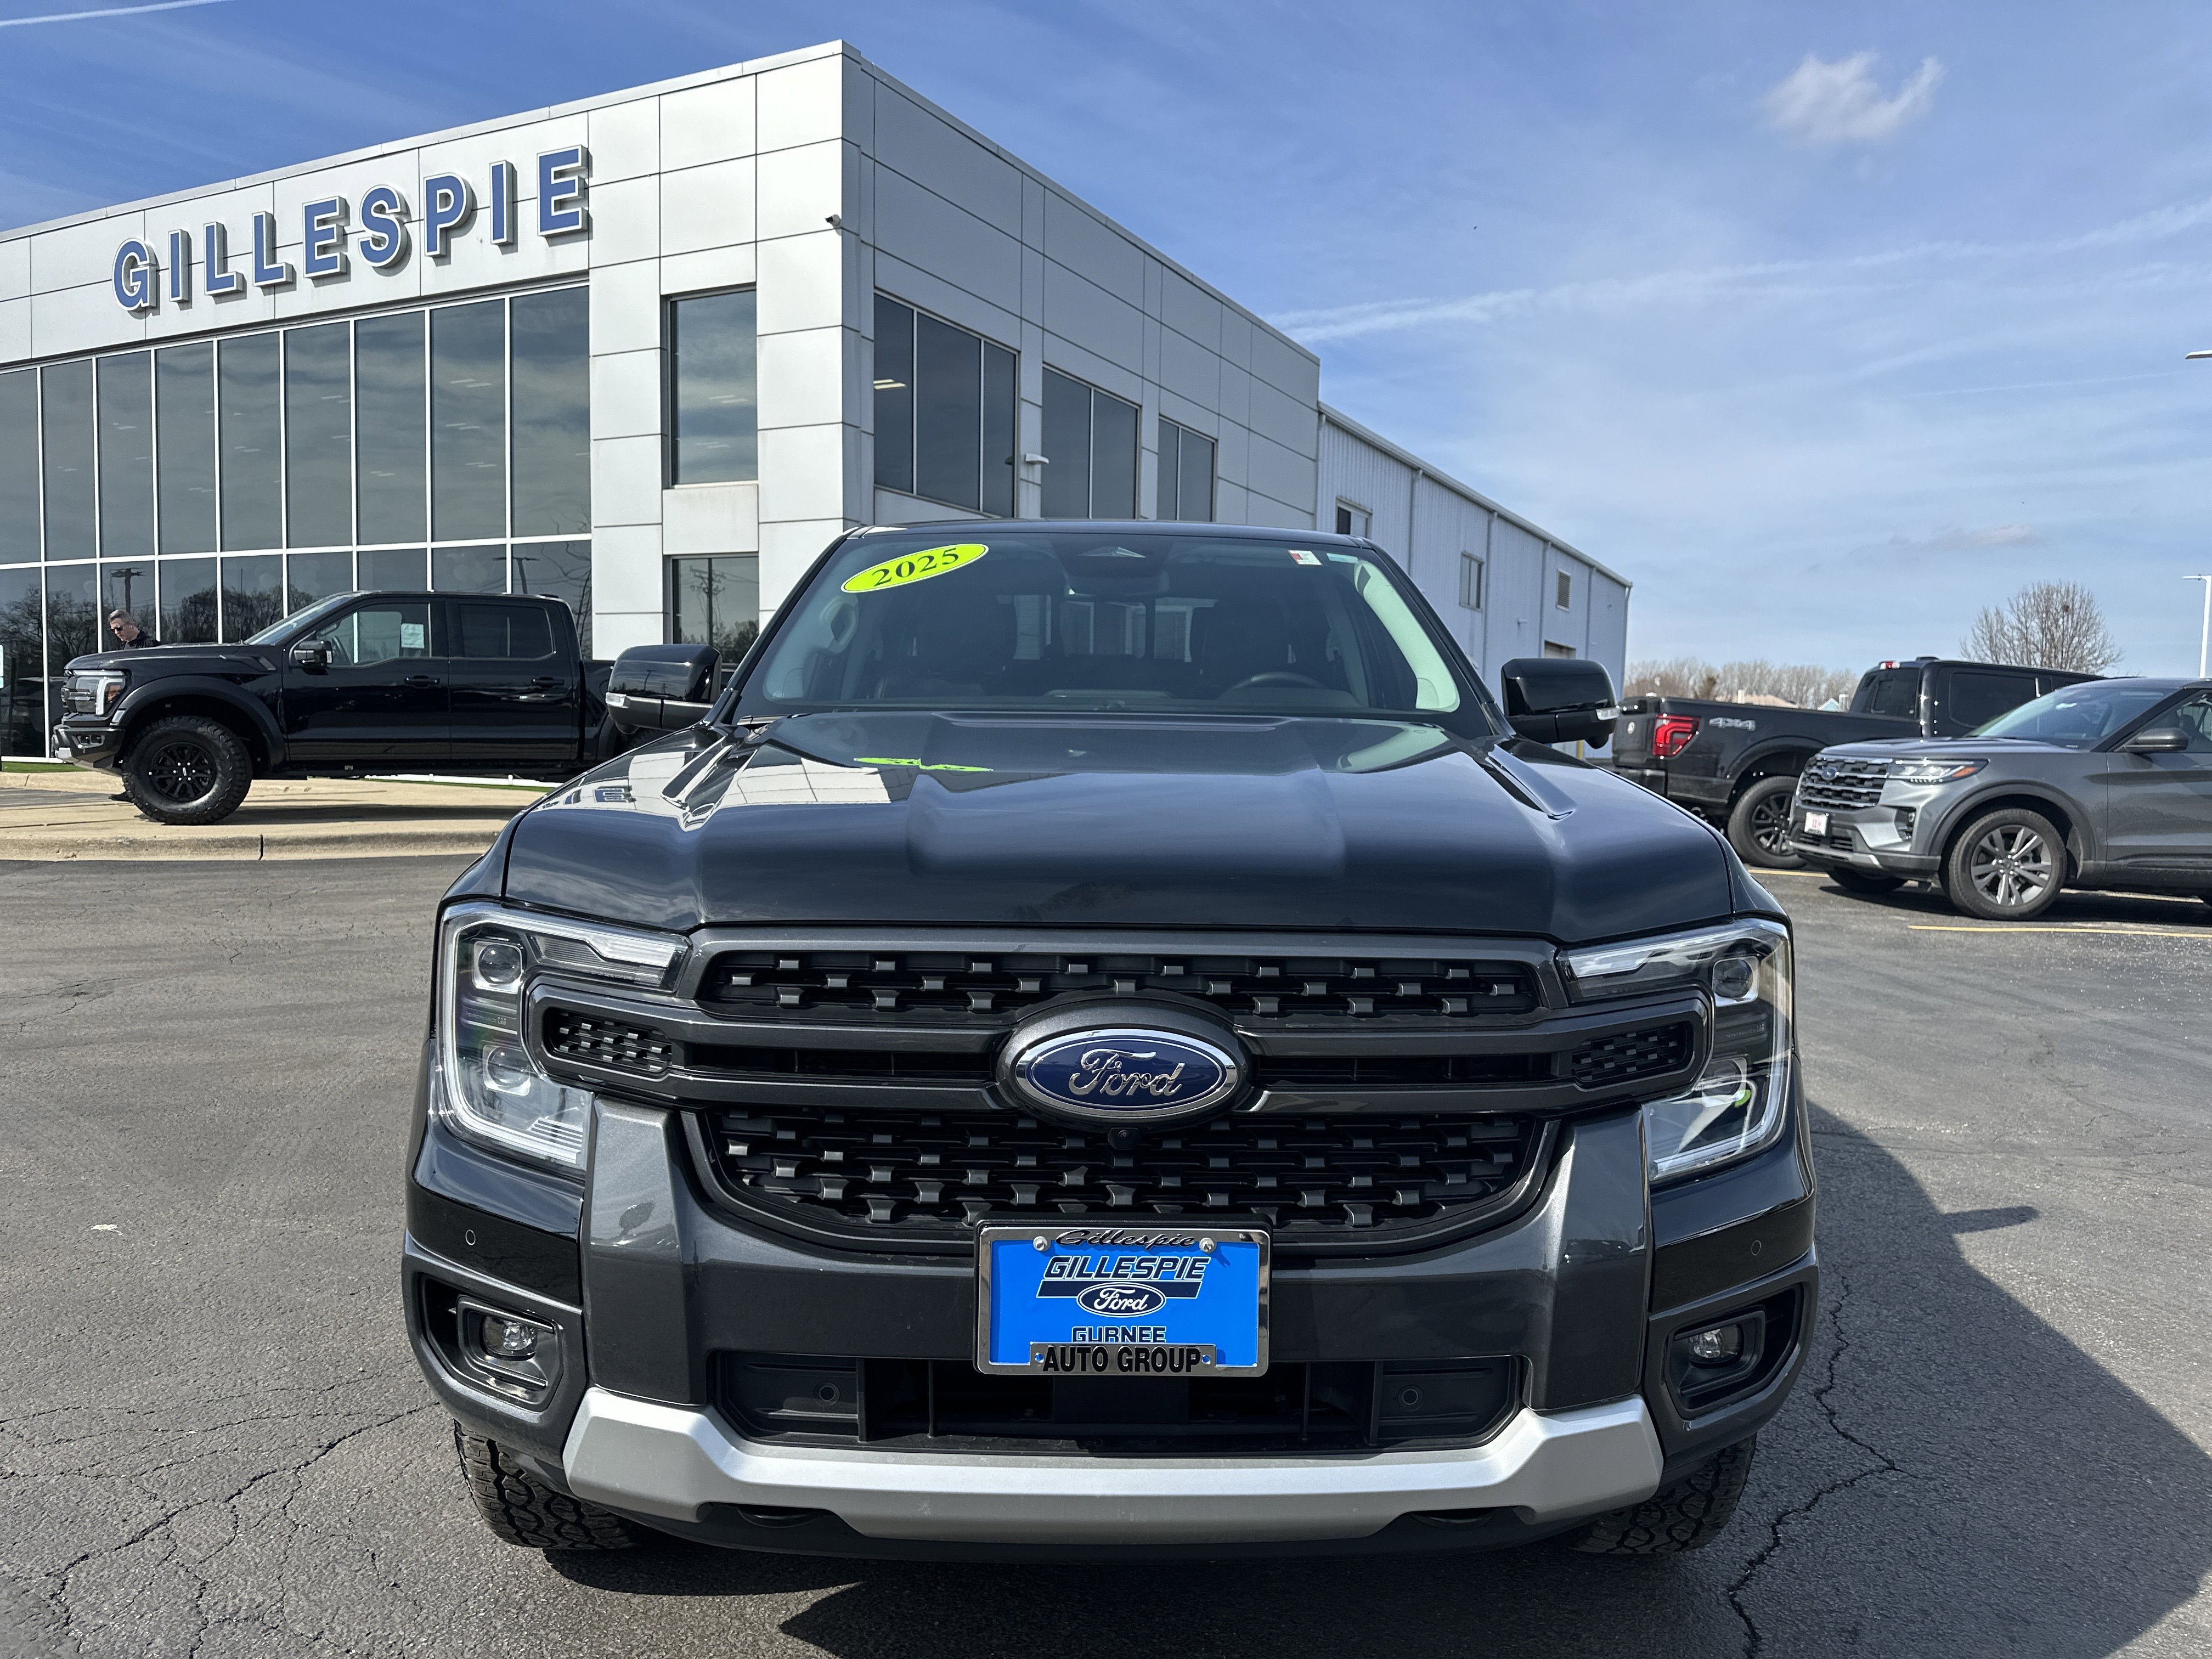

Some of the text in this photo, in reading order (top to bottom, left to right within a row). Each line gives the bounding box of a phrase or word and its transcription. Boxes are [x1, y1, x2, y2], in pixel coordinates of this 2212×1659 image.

[112, 145, 590, 312] GILLESPIE
[871, 548, 959, 587] 2025
[1069, 1048, 1185, 1096] Ford
[1056, 1229, 1195, 1251] Gillespie
[1043, 1255, 1211, 1280] GILLESPIE
[1093, 1287, 1148, 1311] Ford
[1071, 1325, 1167, 1343] GURNEE
[1043, 1345, 1201, 1373] AUTO GROUP
